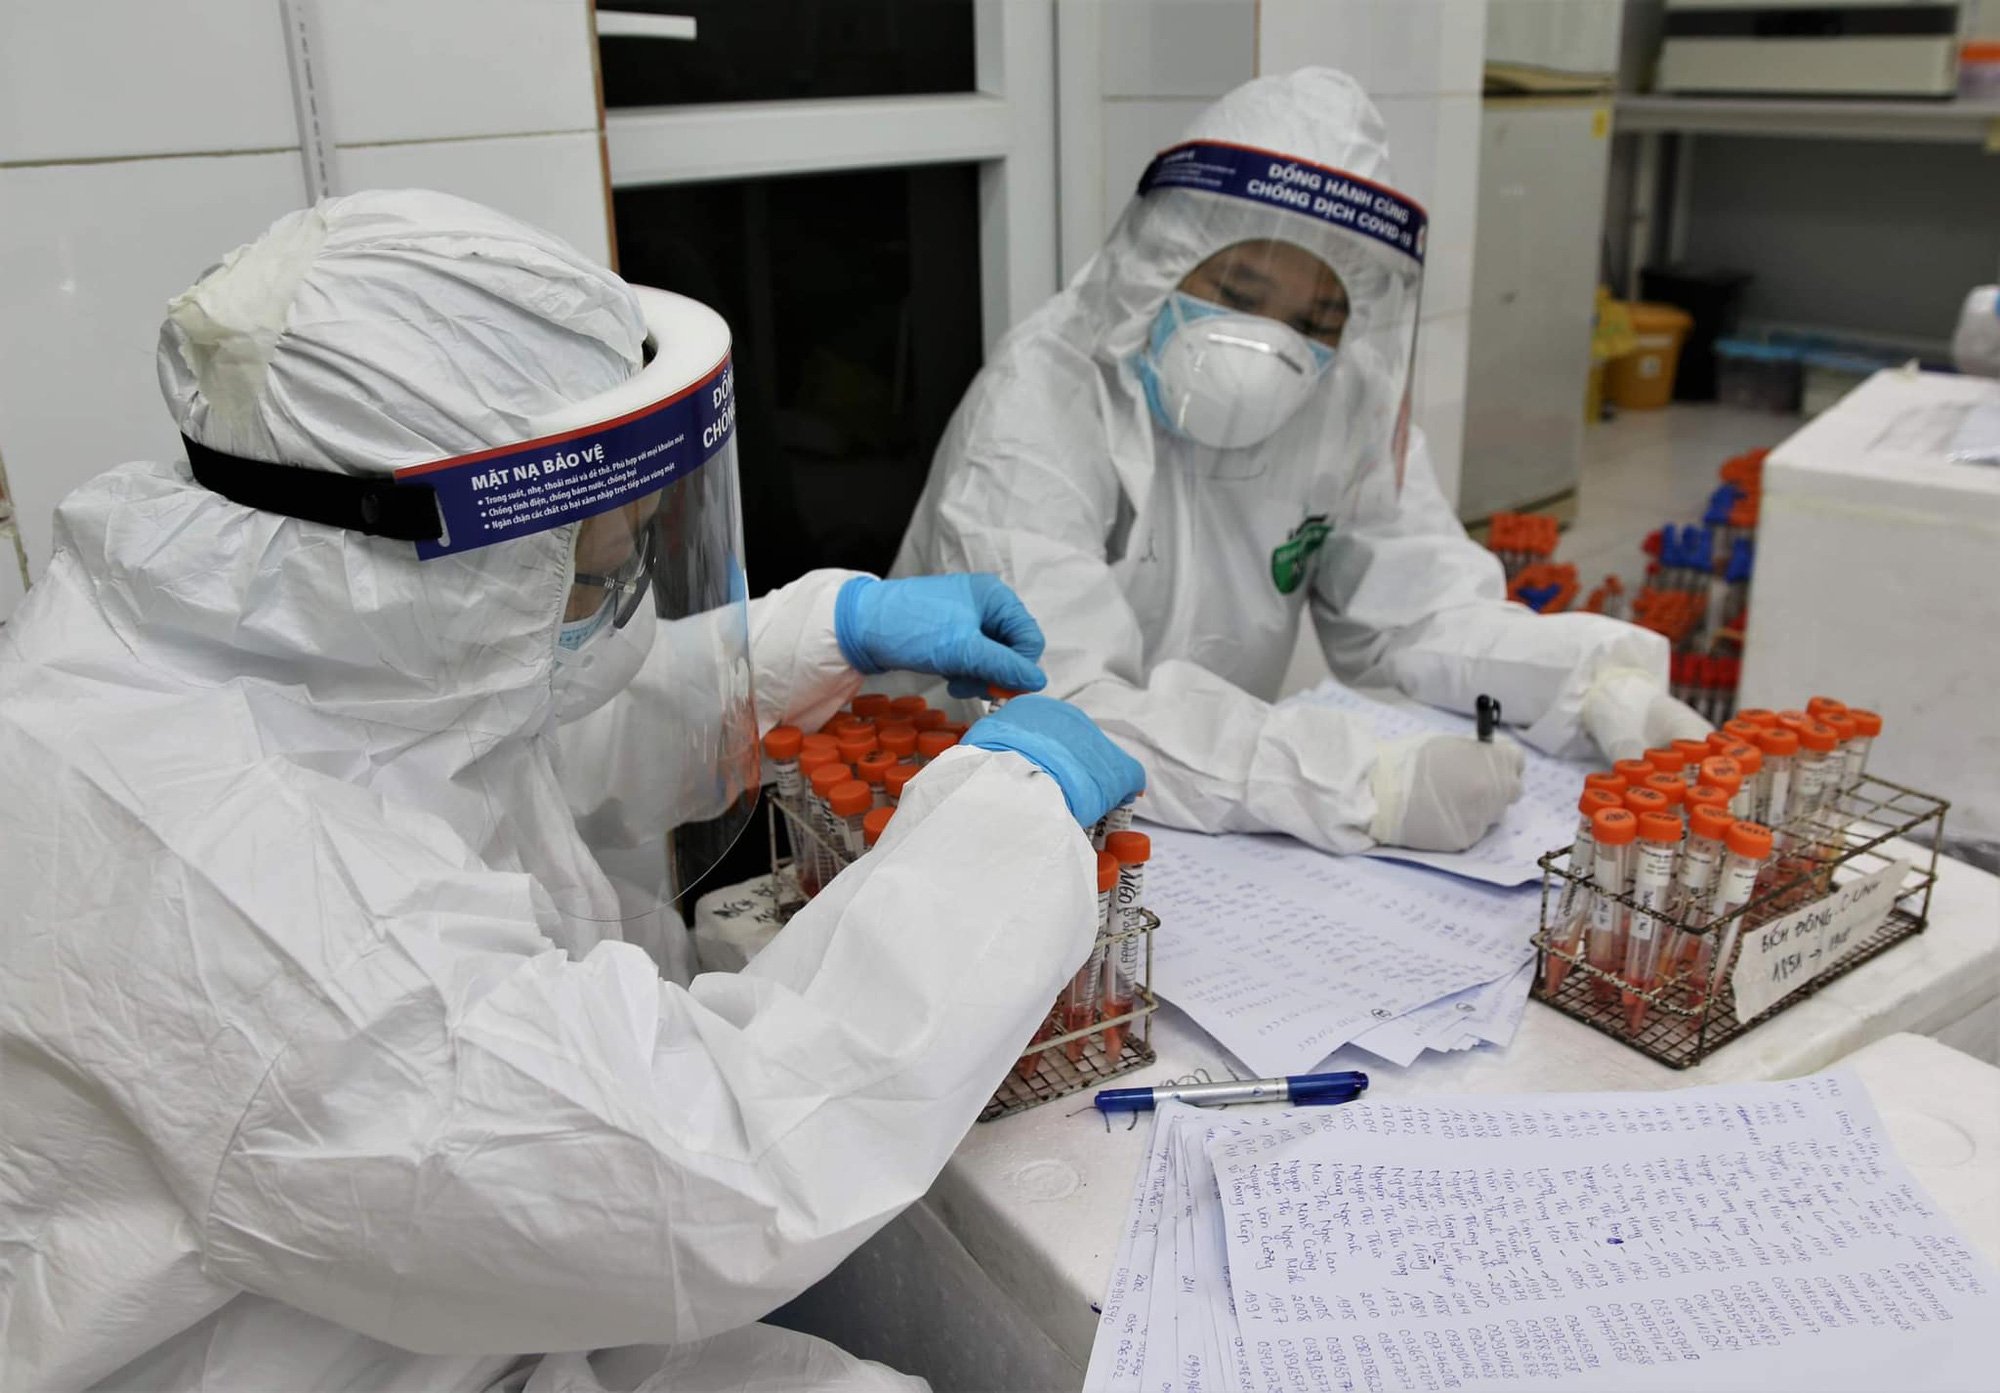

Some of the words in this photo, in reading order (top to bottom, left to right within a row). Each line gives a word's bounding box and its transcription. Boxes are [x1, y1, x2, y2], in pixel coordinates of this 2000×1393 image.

[1247, 179, 1311, 208] CHỐNG
[1313, 197, 1356, 220] DỊCH
[1268, 163, 1322, 190] ĐỒNG
[1325, 178, 1373, 207] HÀNH
[1373, 196, 1409, 225] CÙNG
[713, 369, 734, 409] ĐỒN
[703, 396, 736, 448] CHỐN
[471, 468, 509, 491] MẶT
[513, 463, 541, 481] NẠ
[542, 452, 580, 474] BẢO
[581, 443, 605, 464] VỆ
[1528, 1240, 1543, 1265] Loan
[1290, 1293, 1311, 1321] 2008
[1359, 1291, 1380, 1318] 2010
[1464, 1281, 1490, 1308] 2010
[1487, 1280, 1507, 1303] 2010
[1265, 1292, 1288, 1323] 1967
